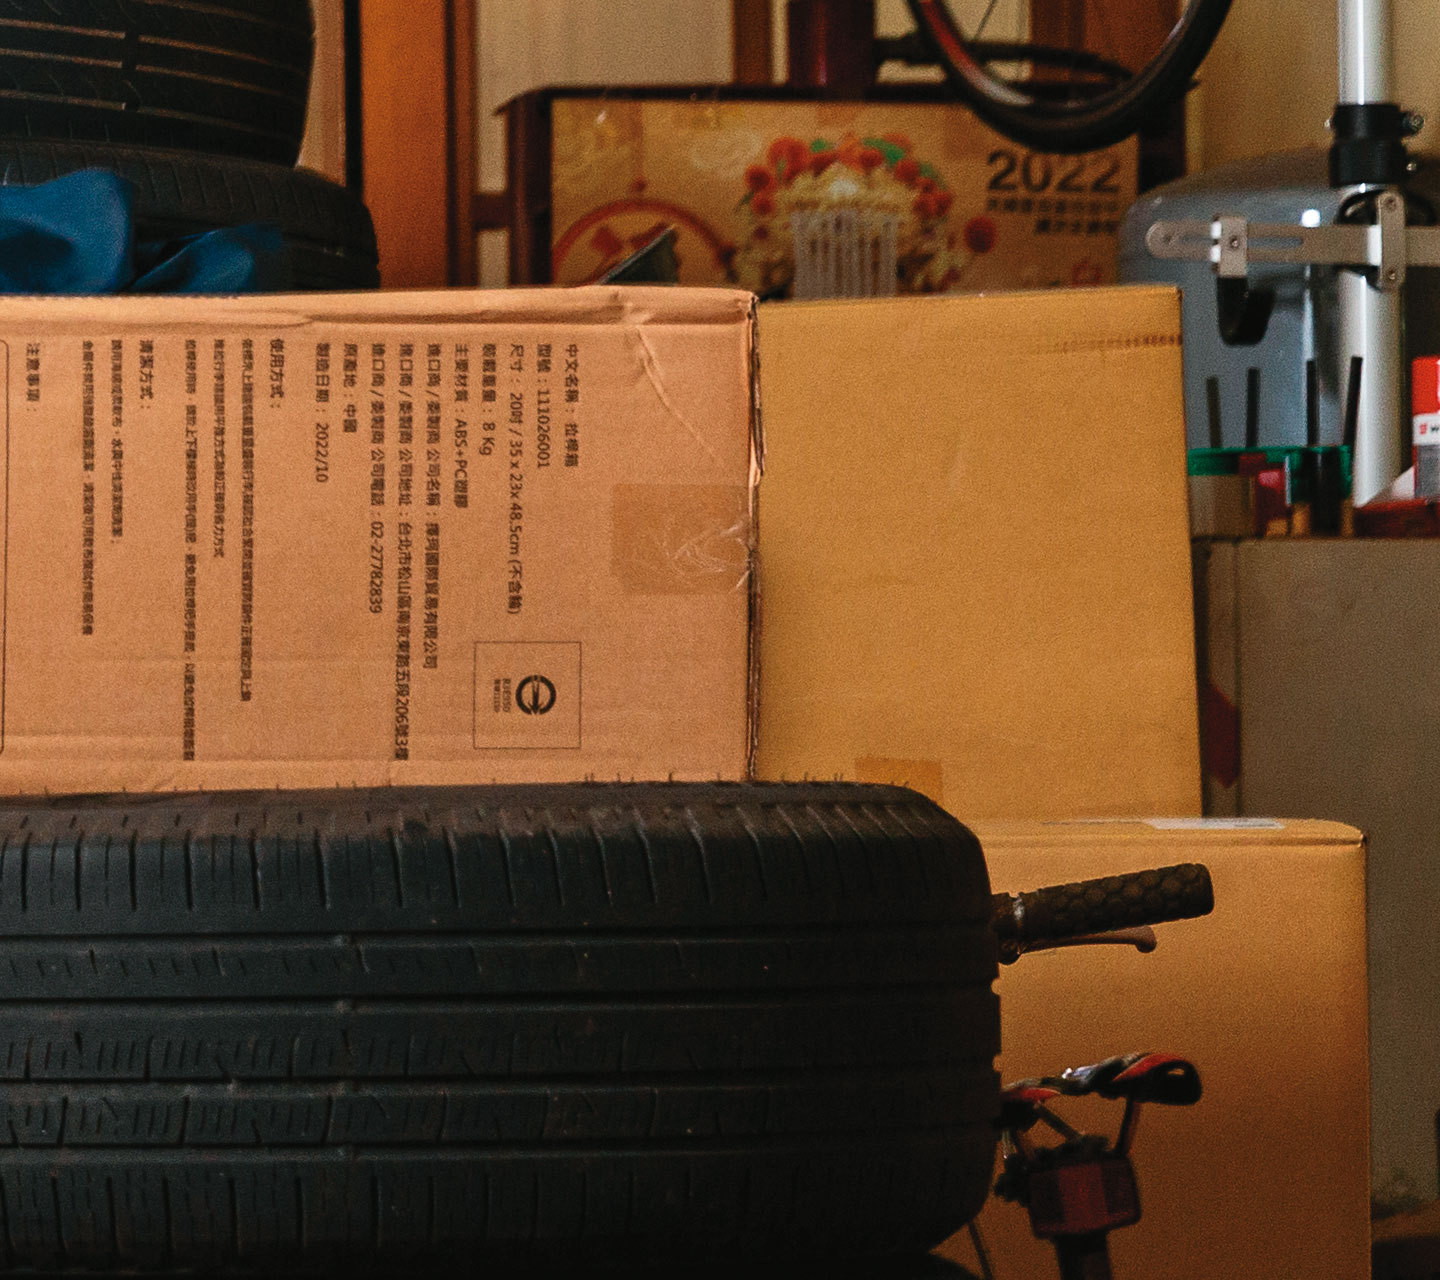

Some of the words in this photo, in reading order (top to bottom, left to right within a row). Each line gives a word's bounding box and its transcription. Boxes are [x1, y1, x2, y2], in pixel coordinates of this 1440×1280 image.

[986, 149, 1122, 193] 2022
[315, 423, 329, 483] 2022/10
[479, 437, 495, 456] Kg
